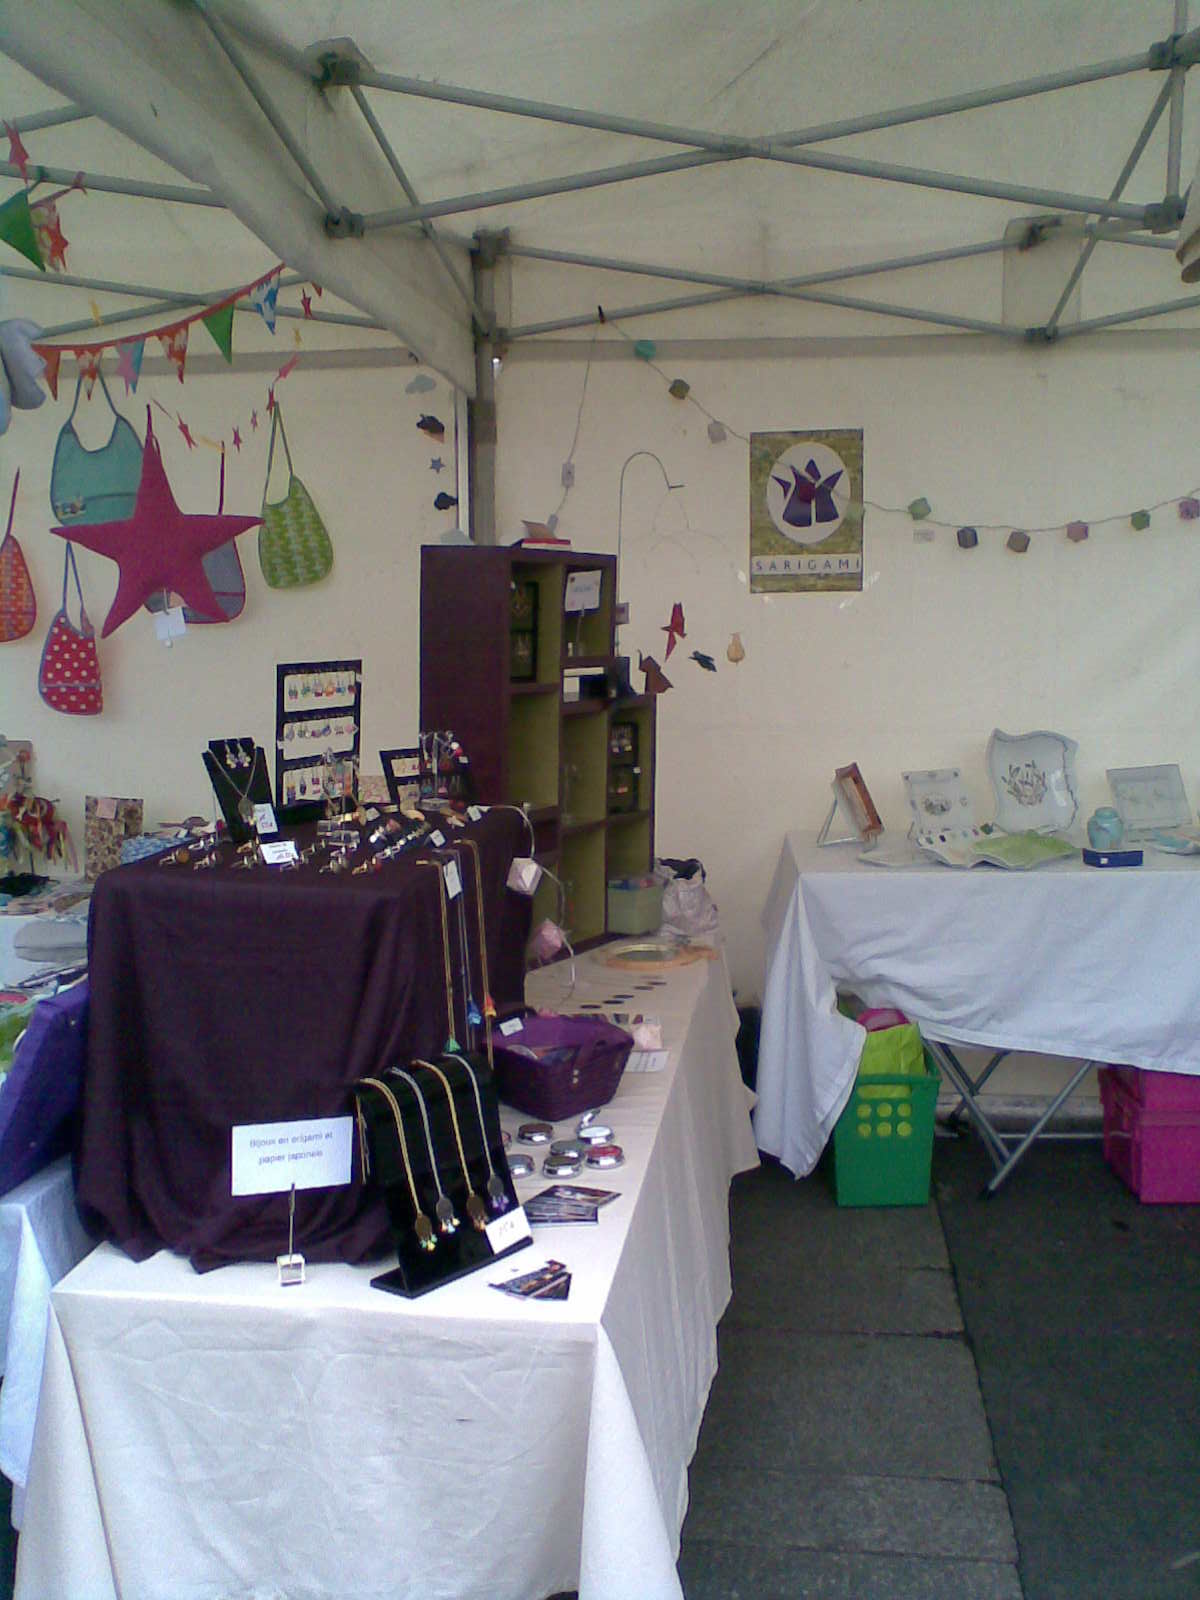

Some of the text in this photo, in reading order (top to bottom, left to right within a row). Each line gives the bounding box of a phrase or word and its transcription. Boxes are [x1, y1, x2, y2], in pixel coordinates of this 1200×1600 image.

[755, 559, 860, 572] SARIGAMI
[278, 1137, 289, 1145] en
[291, 1132, 323, 1144] origami
